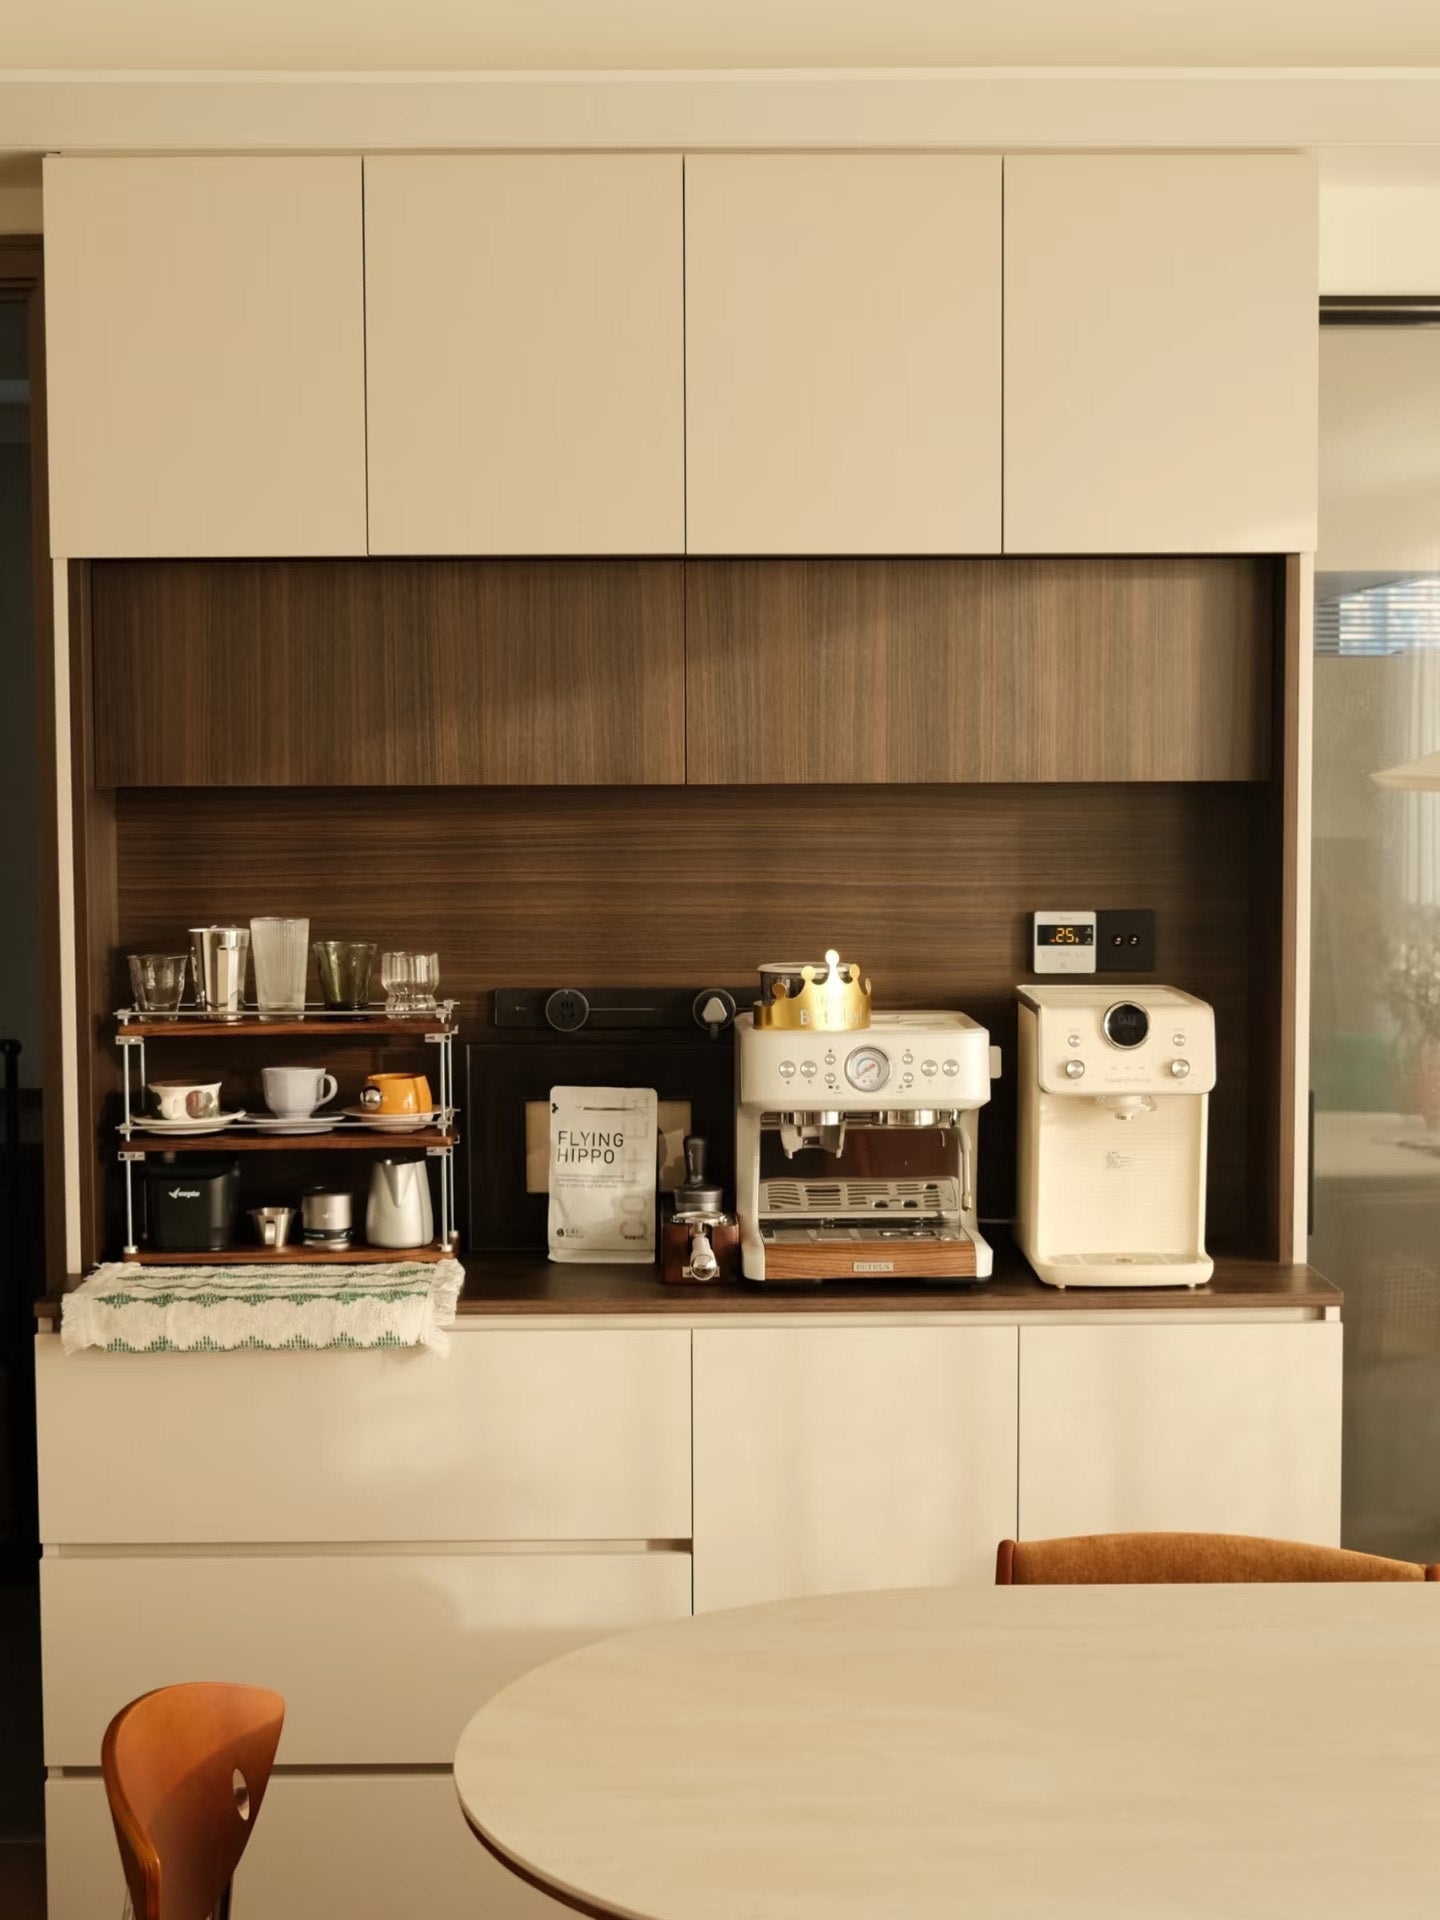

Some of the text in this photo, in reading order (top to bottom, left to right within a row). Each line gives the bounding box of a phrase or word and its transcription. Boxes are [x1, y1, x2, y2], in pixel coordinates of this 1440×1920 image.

[1056, 927, 1075, 943] 25
[558, 1130, 624, 1148] FLYING
[557, 1147, 615, 1165] HIPPO
